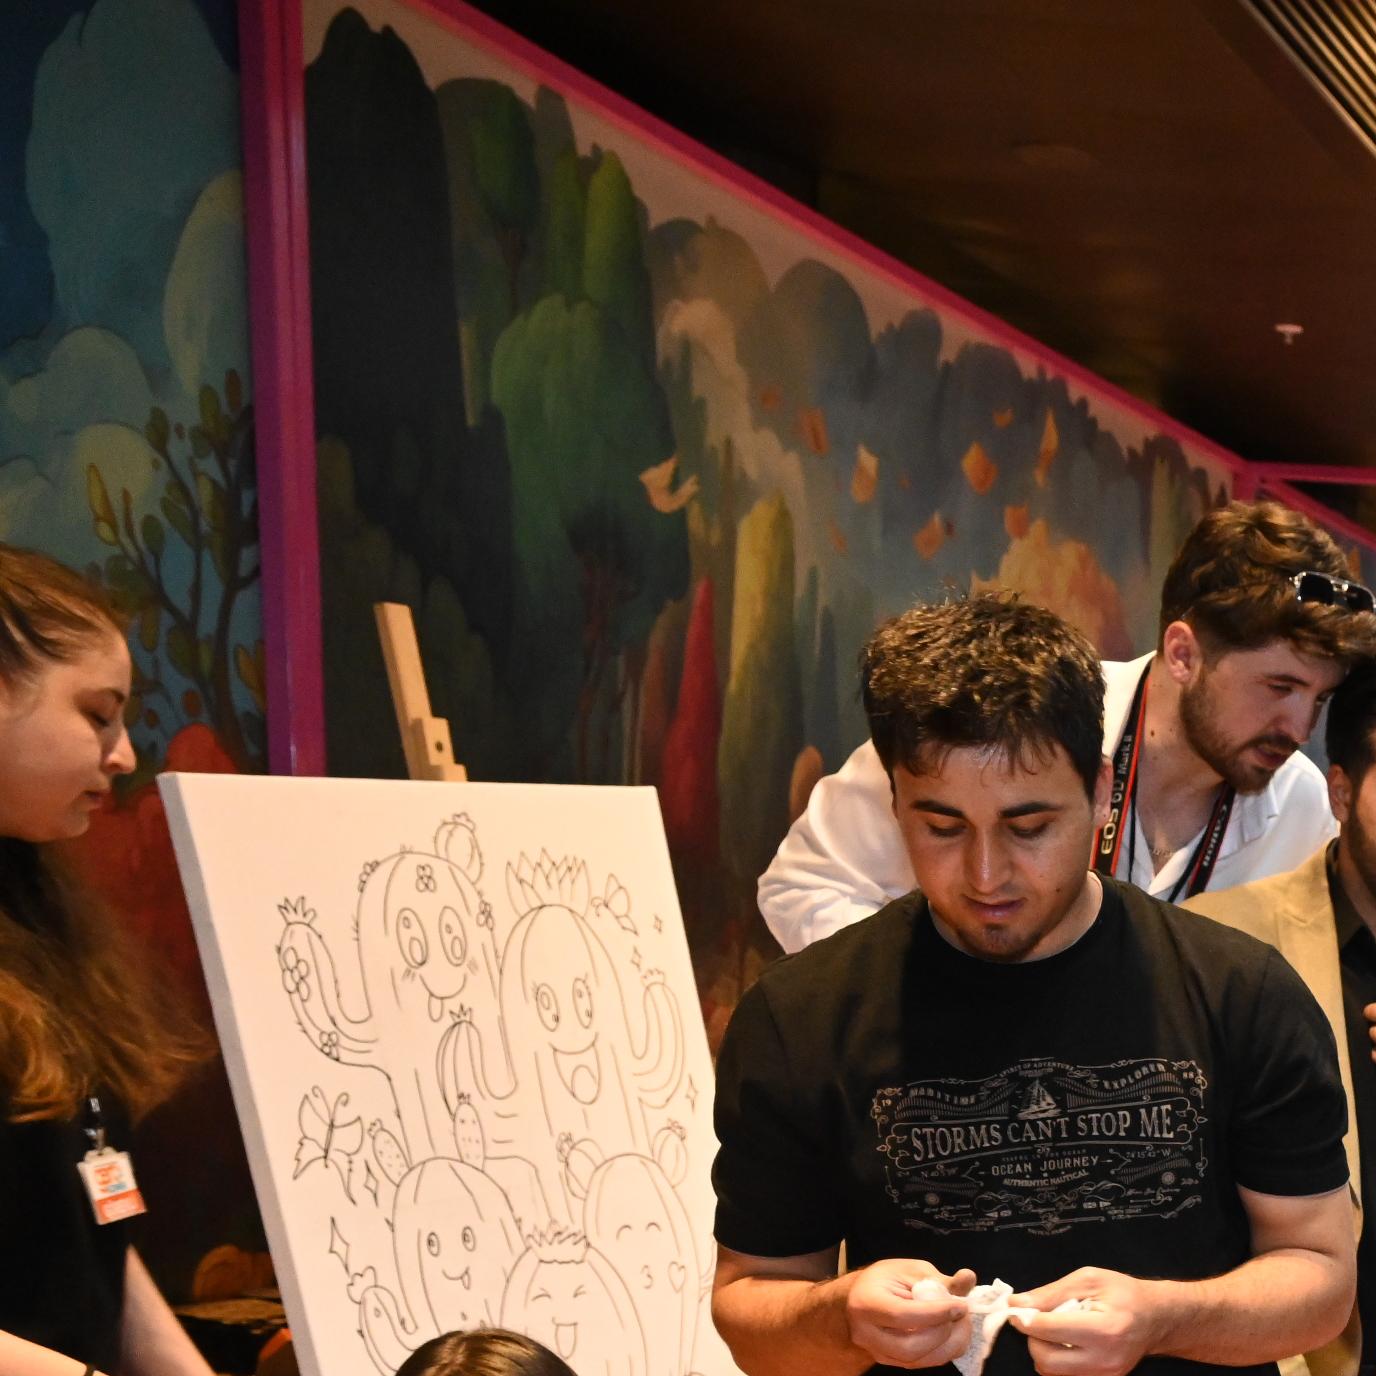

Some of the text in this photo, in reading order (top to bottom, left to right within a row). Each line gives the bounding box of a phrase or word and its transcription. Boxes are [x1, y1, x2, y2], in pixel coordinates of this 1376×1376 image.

[1103, 1063, 1166, 1089] EXPLORER
[911, 1104, 1175, 1162] STORMS CAN'T STOP ME
[991, 1161, 1033, 1176] OCEAN
[1039, 1155, 1099, 1172] JOURNEY
[1002, 1169, 1089, 1188] AUTHENTIC NAUTICAL
